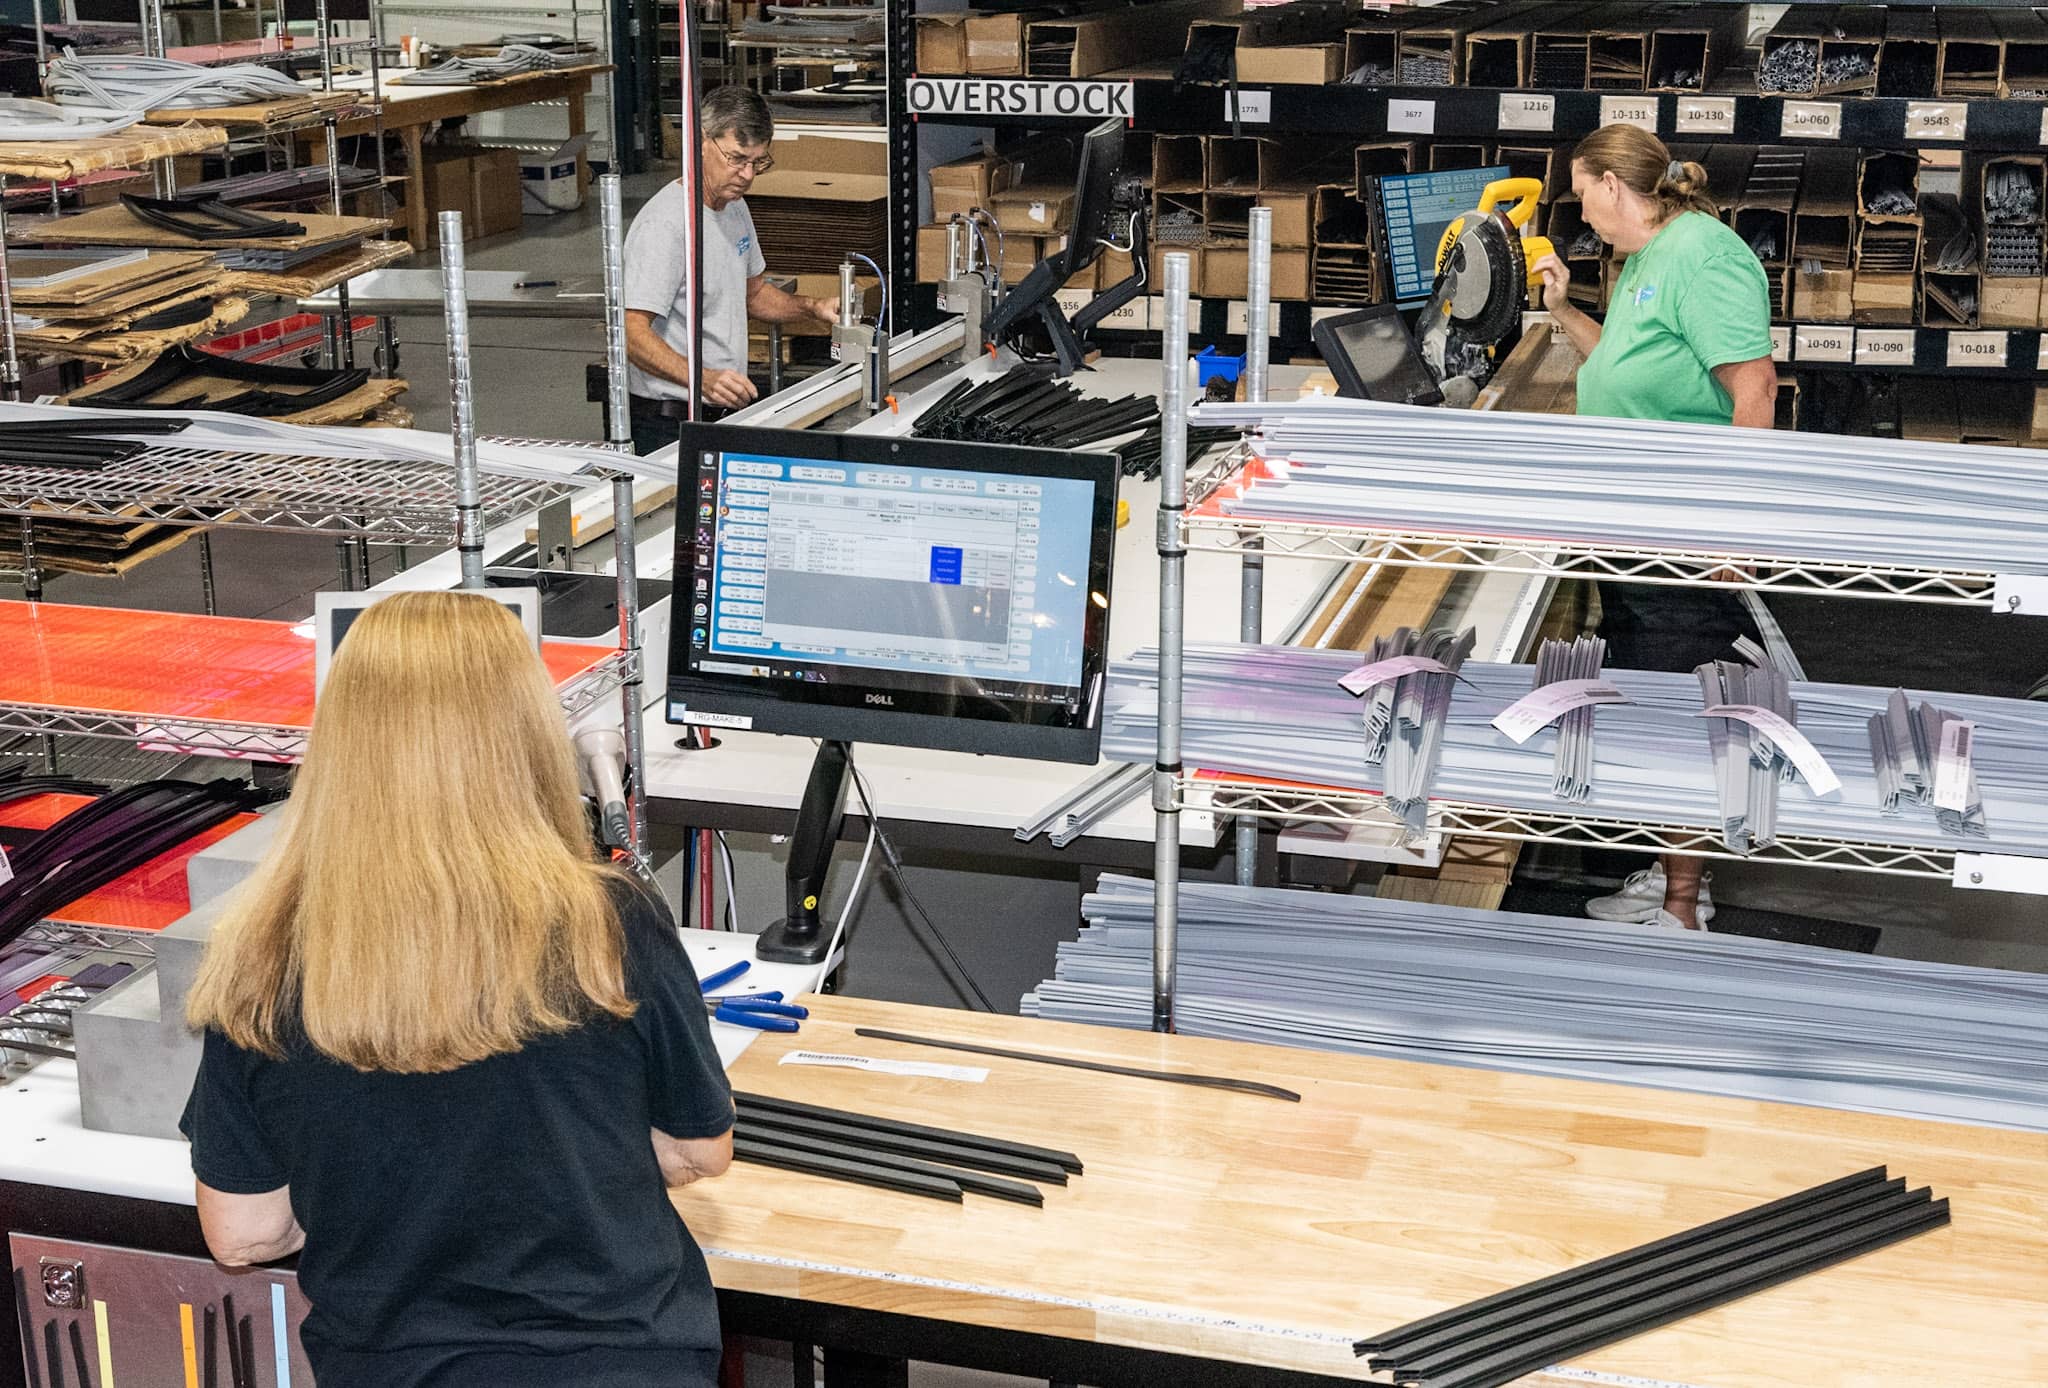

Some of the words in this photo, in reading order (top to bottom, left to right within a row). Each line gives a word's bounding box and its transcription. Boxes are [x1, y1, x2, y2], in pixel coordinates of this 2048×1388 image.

[909, 81, 1128, 115] OVERSTOCK
[1523, 101, 1549, 112] 1216
[1405, 110, 1422, 118] 3677
[1611, 110, 1647, 120] 10-131
[1688, 110, 1724, 121] 10-130
[1793, 114, 1830, 125] 10-060
[1923, 116, 1950, 126] 9548
[1062, 302, 1079, 310] 356
[1807, 339, 1842, 349] 10-091
[1868, 342, 1903, 352] 10-090
[1959, 344, 1995, 354] 10-018
[865, 694, 895, 706] DELL
